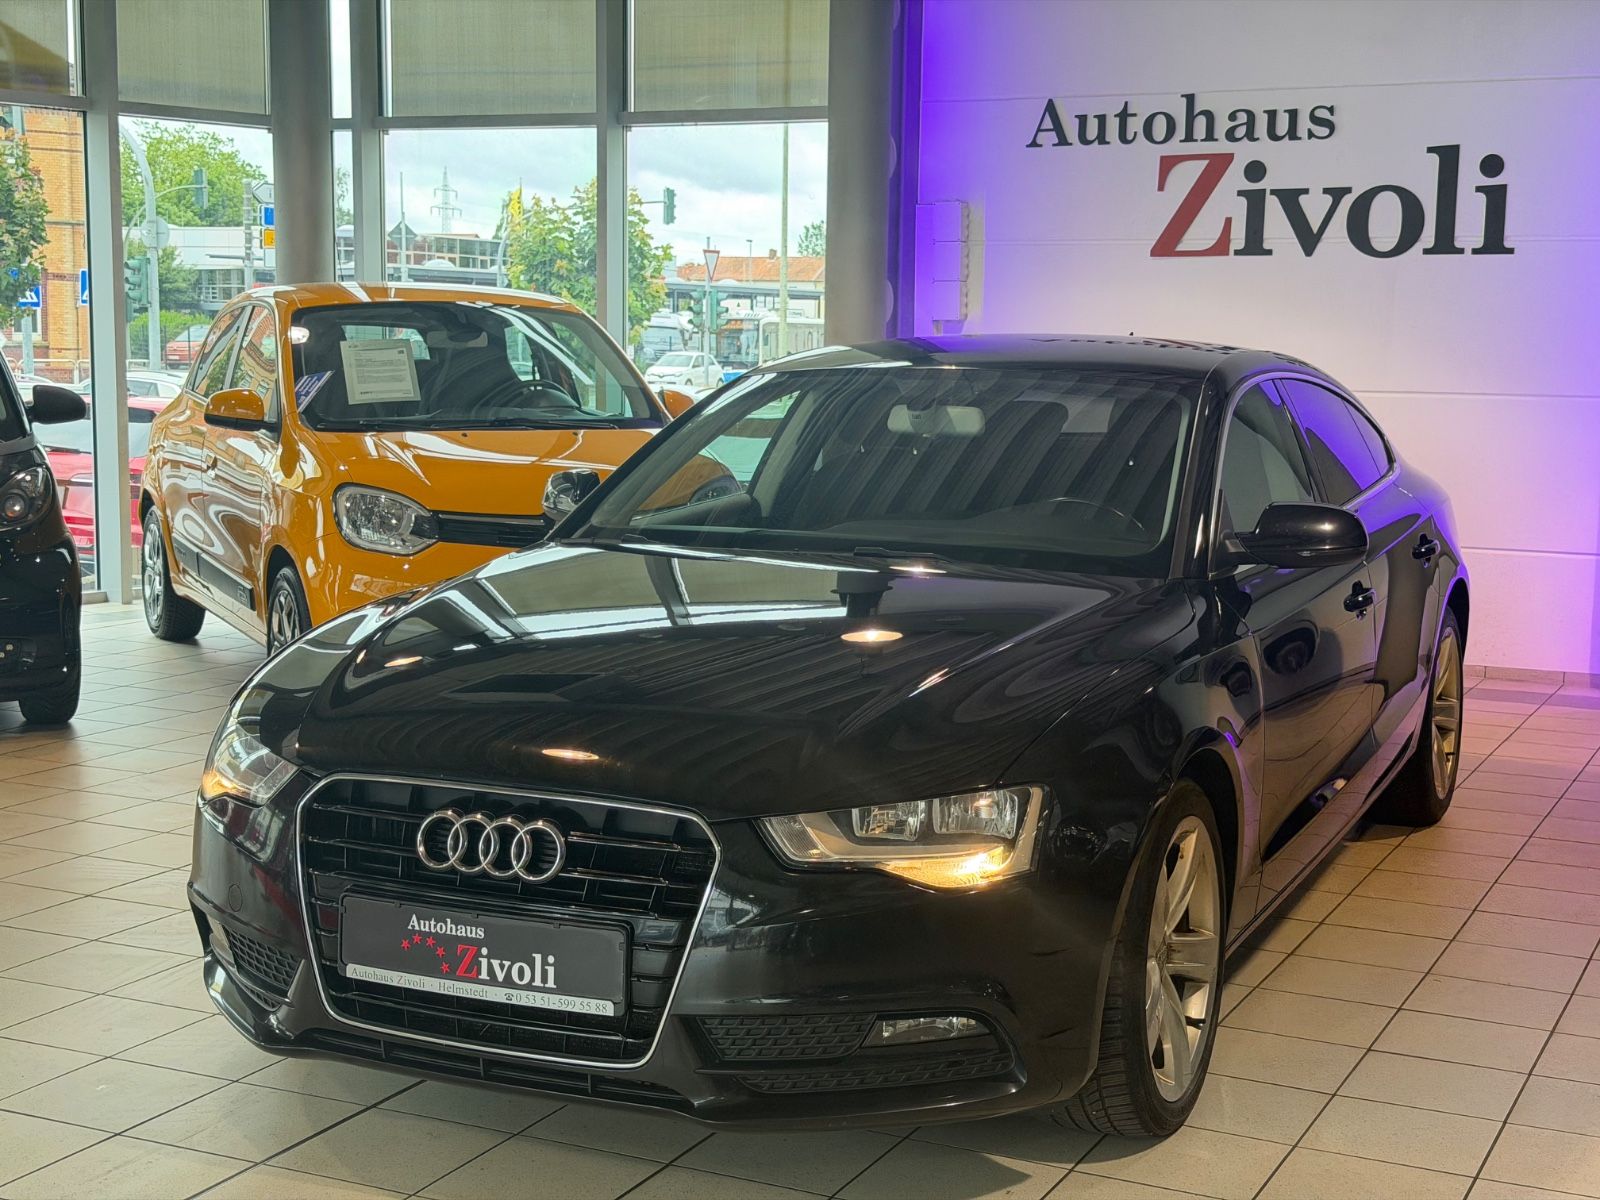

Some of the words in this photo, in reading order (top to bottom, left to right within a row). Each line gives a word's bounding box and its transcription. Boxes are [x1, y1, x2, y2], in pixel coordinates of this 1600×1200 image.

[1025, 93, 1336, 148] Autohaus
[1150, 144, 1515, 259] Zivoli
[407, 913, 485, 939] Autohaus
[456, 944, 557, 989] Zivoli
[351, 967, 394, 983] Autohaus
[396, 974, 425, 989] Zivoli
[437, 981, 488, 999] Helmstedt
[525, 994, 537, 1005] 53
[579, 1000, 592, 1011] 55
[594, 1002, 608, 1014] 88
